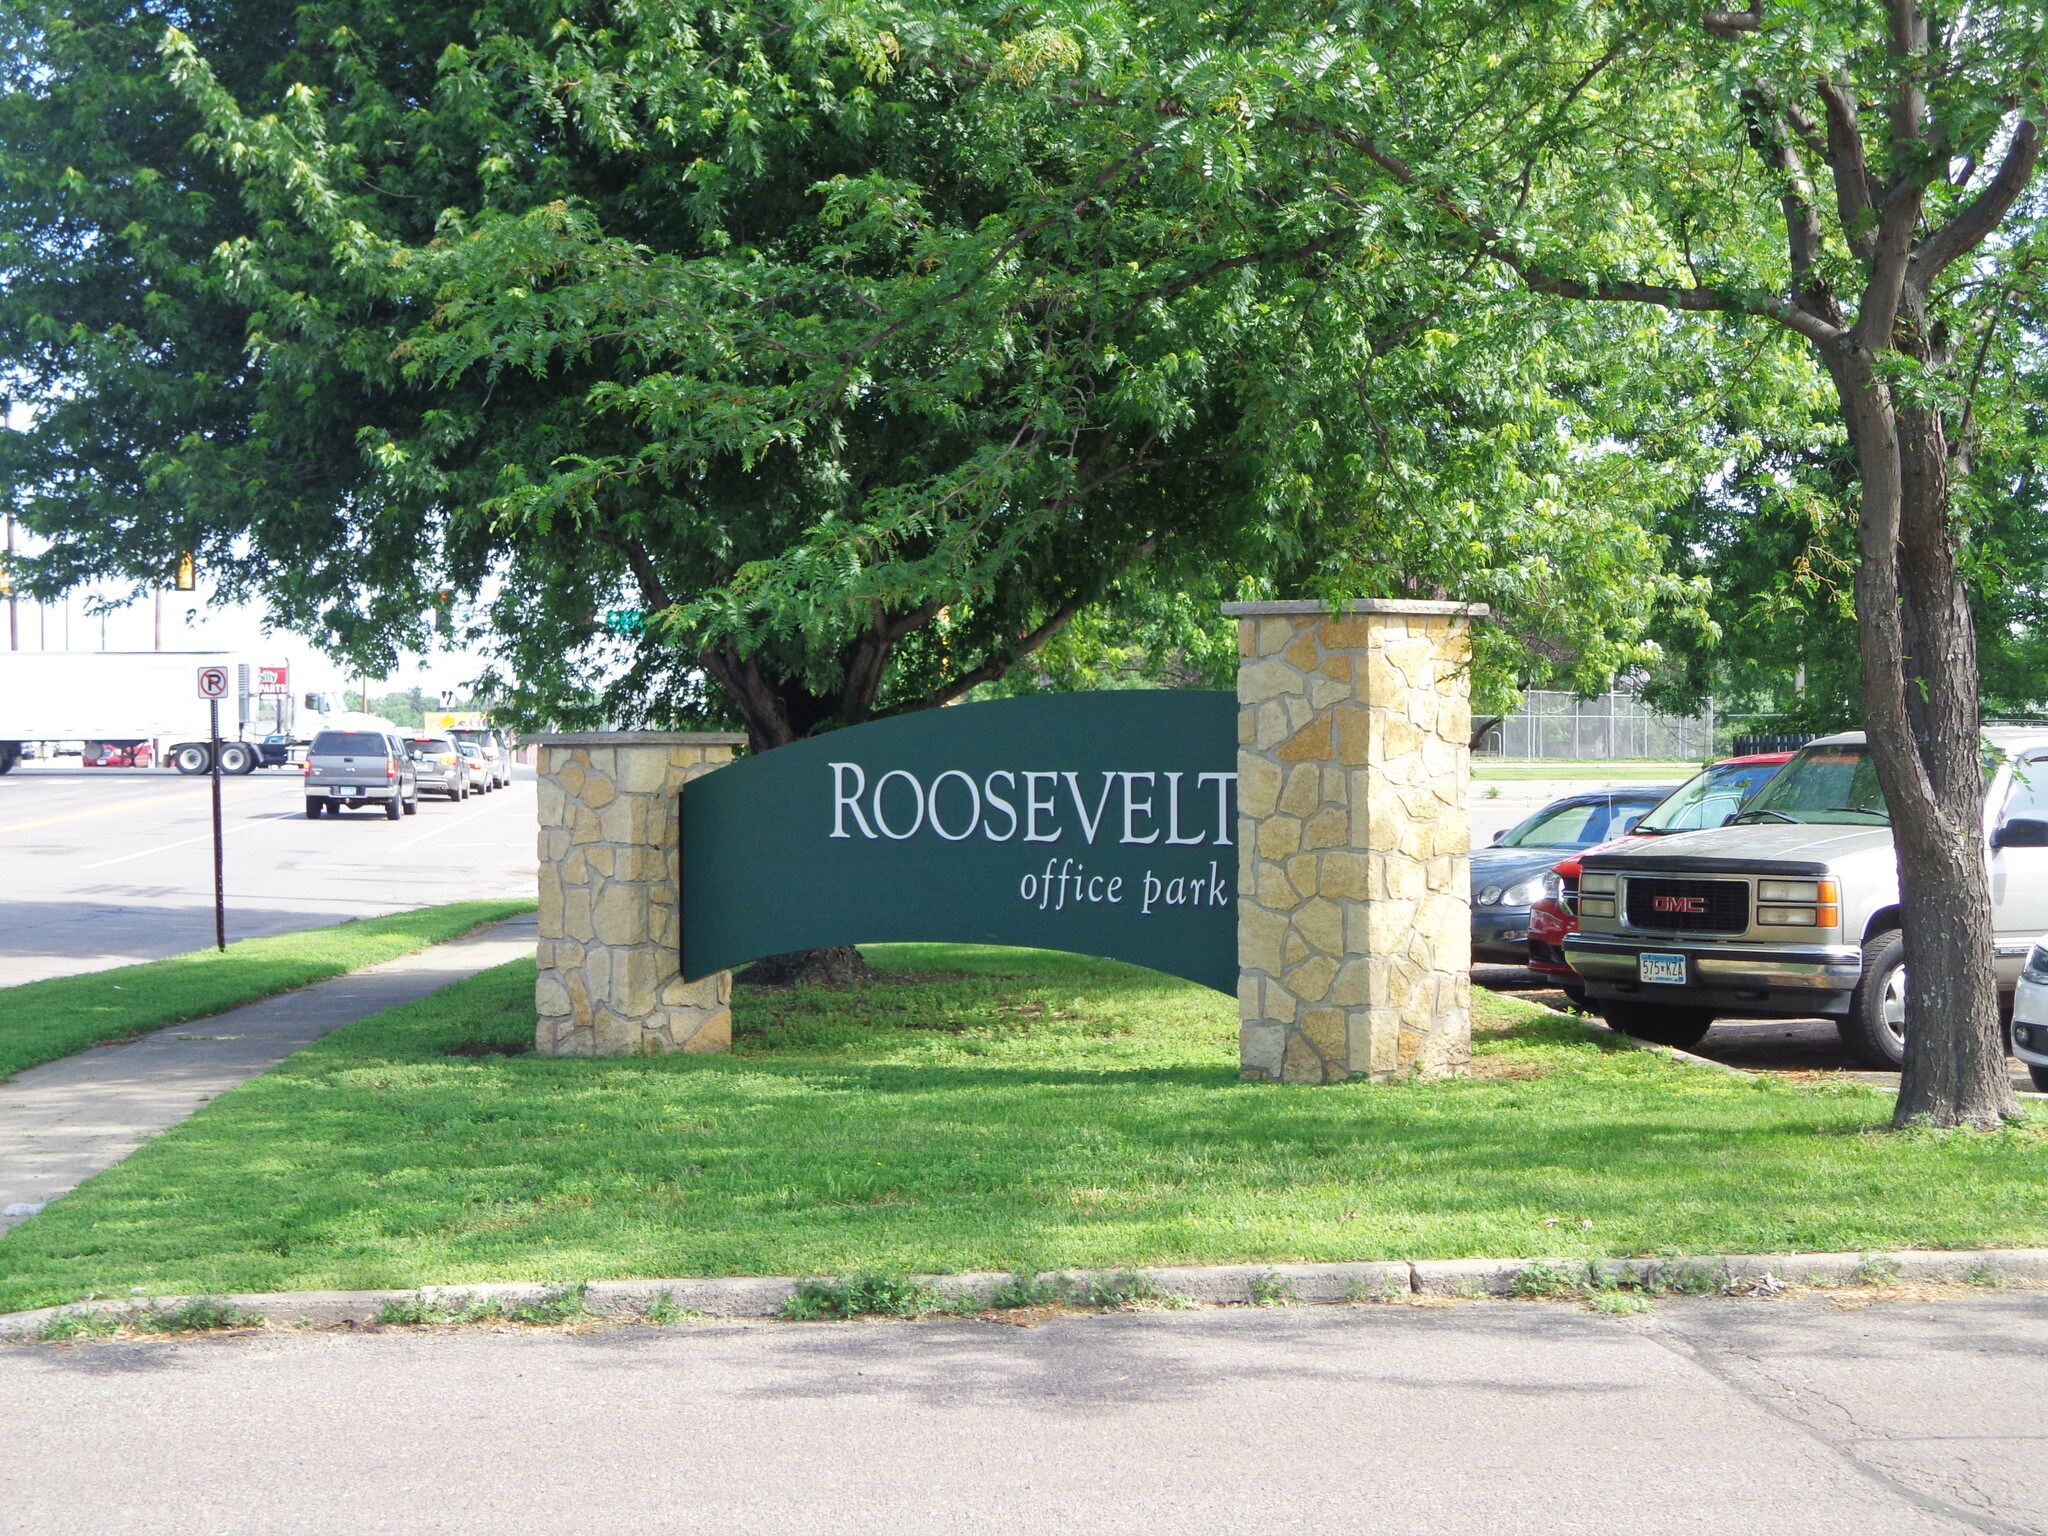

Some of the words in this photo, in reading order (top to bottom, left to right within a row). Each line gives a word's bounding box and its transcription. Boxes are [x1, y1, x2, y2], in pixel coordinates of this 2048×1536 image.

[208, 674, 221, 691] P
[259, 683, 287, 693] PARTS
[828, 762, 1238, 845] ROOSEVELT
[1020, 858, 1123, 910] office
[1141, 861, 1228, 914] park
[1653, 896, 1704, 913] GMC
